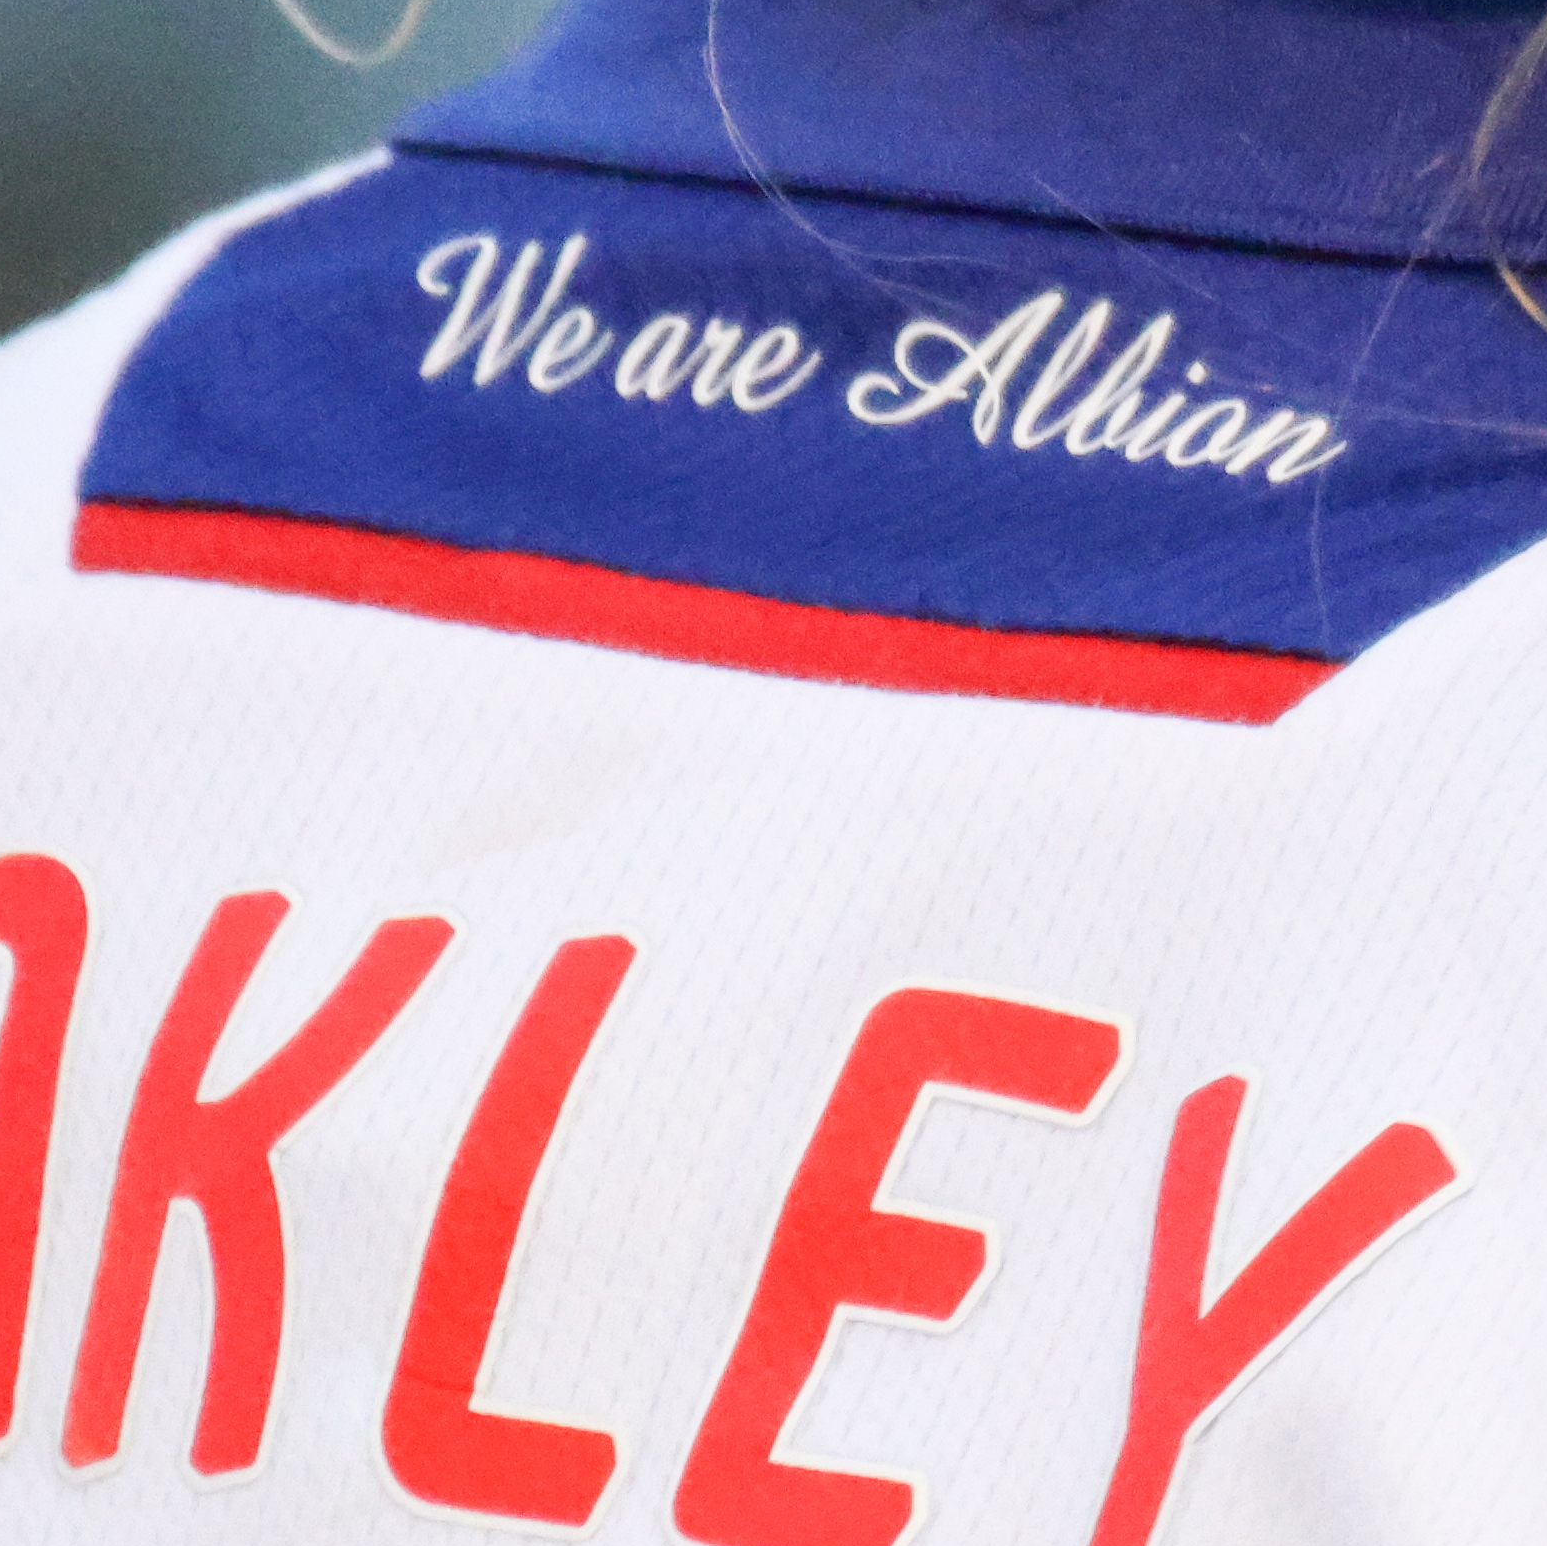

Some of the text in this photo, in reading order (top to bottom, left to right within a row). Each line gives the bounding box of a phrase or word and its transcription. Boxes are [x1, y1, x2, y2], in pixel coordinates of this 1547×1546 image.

[415, 232, 1349, 485] We are Albion
